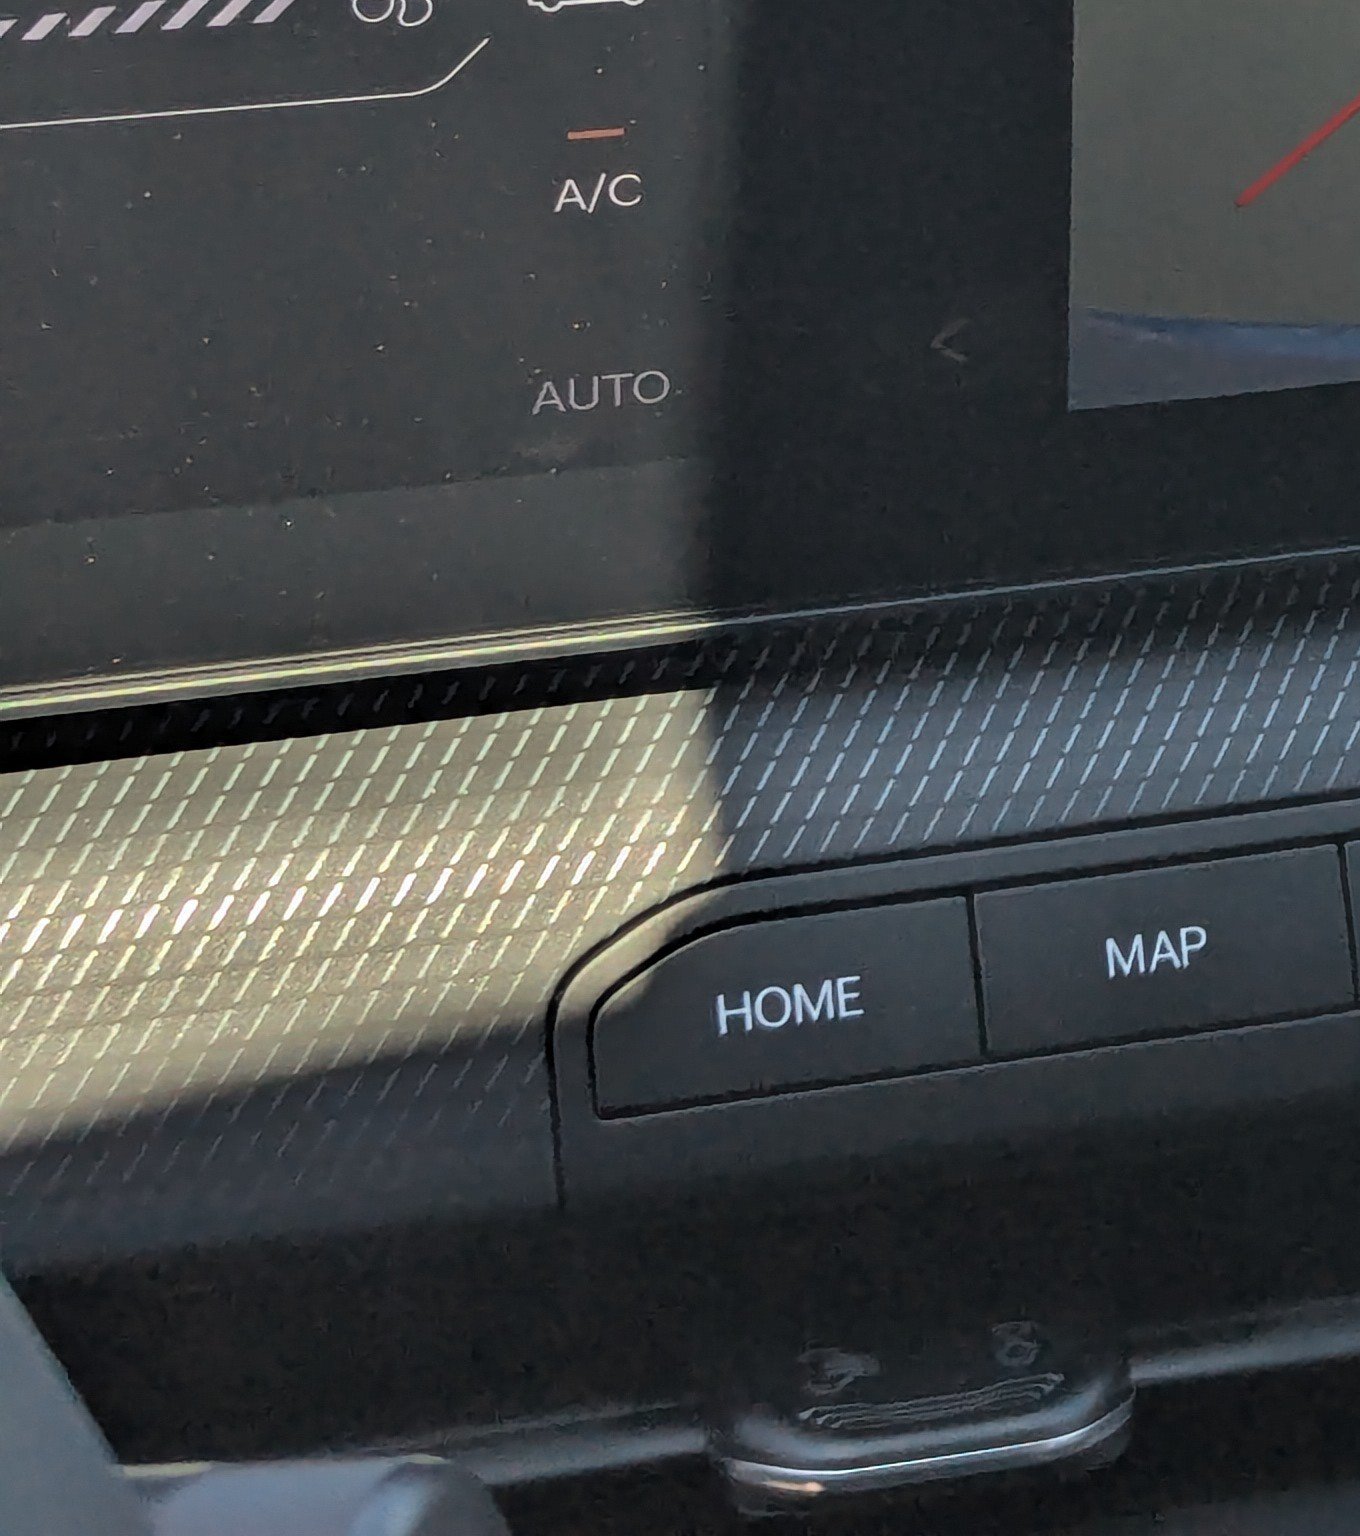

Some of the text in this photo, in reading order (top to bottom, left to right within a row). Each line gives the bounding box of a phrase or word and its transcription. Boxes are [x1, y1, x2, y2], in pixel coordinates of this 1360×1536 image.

[553, 173, 644, 214] A/C
[532, 371, 671, 416] AUTO
[1105, 925, 1209, 981] MAP
[713, 975, 866, 1039] HOME
